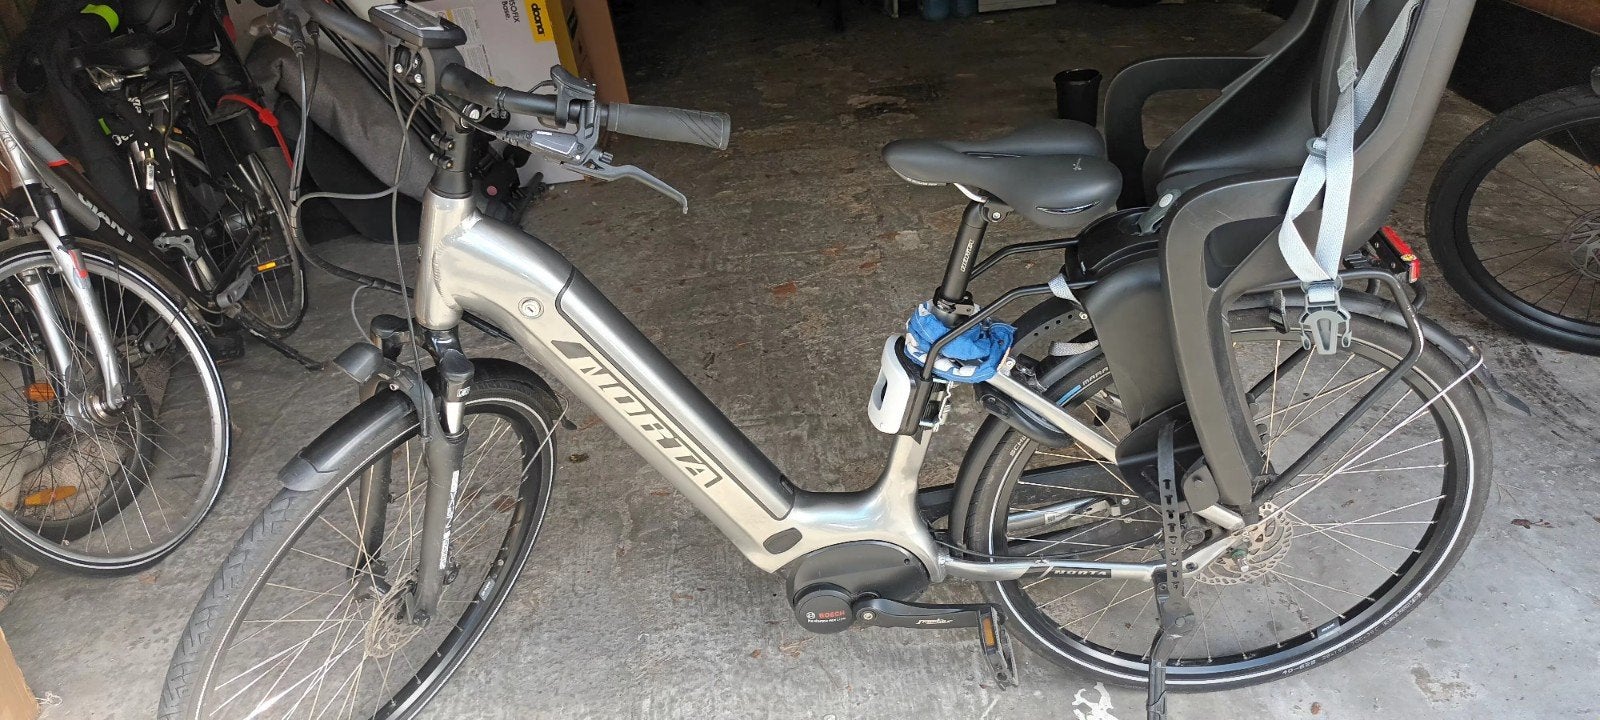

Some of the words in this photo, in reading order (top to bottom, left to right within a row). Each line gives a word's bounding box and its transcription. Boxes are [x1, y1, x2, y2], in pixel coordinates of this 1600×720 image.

[531, 3, 545, 35] doona
[78, 192, 133, 242] GIANT
[568, 355, 718, 487] NORTA
[818, 610, 845, 619] BOSCH
